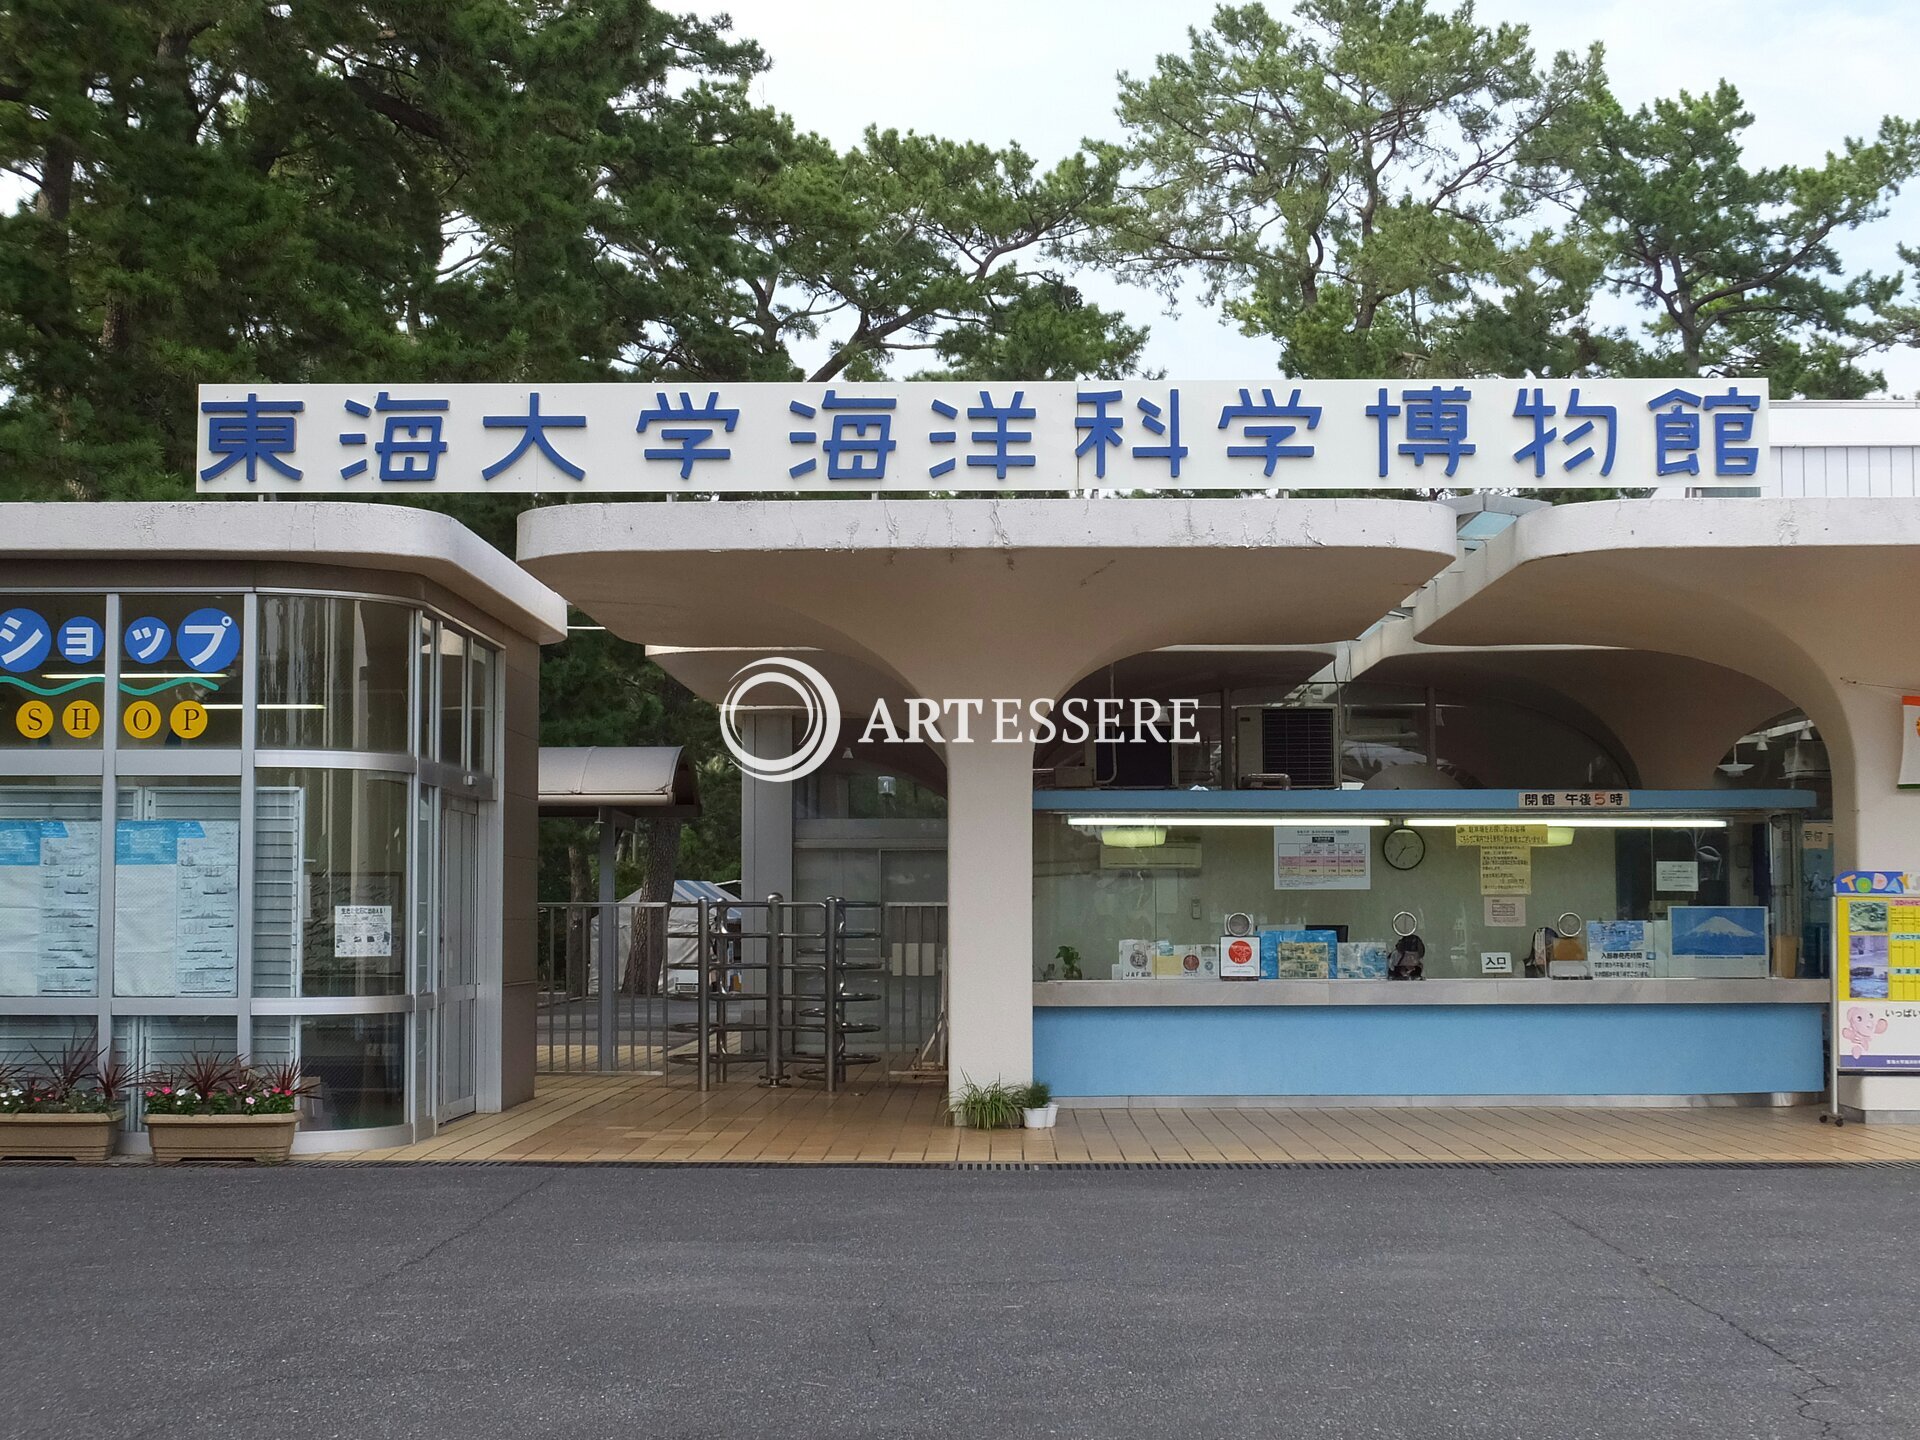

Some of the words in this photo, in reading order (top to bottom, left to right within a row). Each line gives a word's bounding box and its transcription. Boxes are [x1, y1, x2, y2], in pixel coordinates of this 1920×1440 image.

[200, 387, 1761, 482] 東海大学海洋科学博物館
[27, 708, 200, 731] SHOP
[1524, 793, 1556, 806] 閉館
[1486, 957, 1506, 966] 入口
